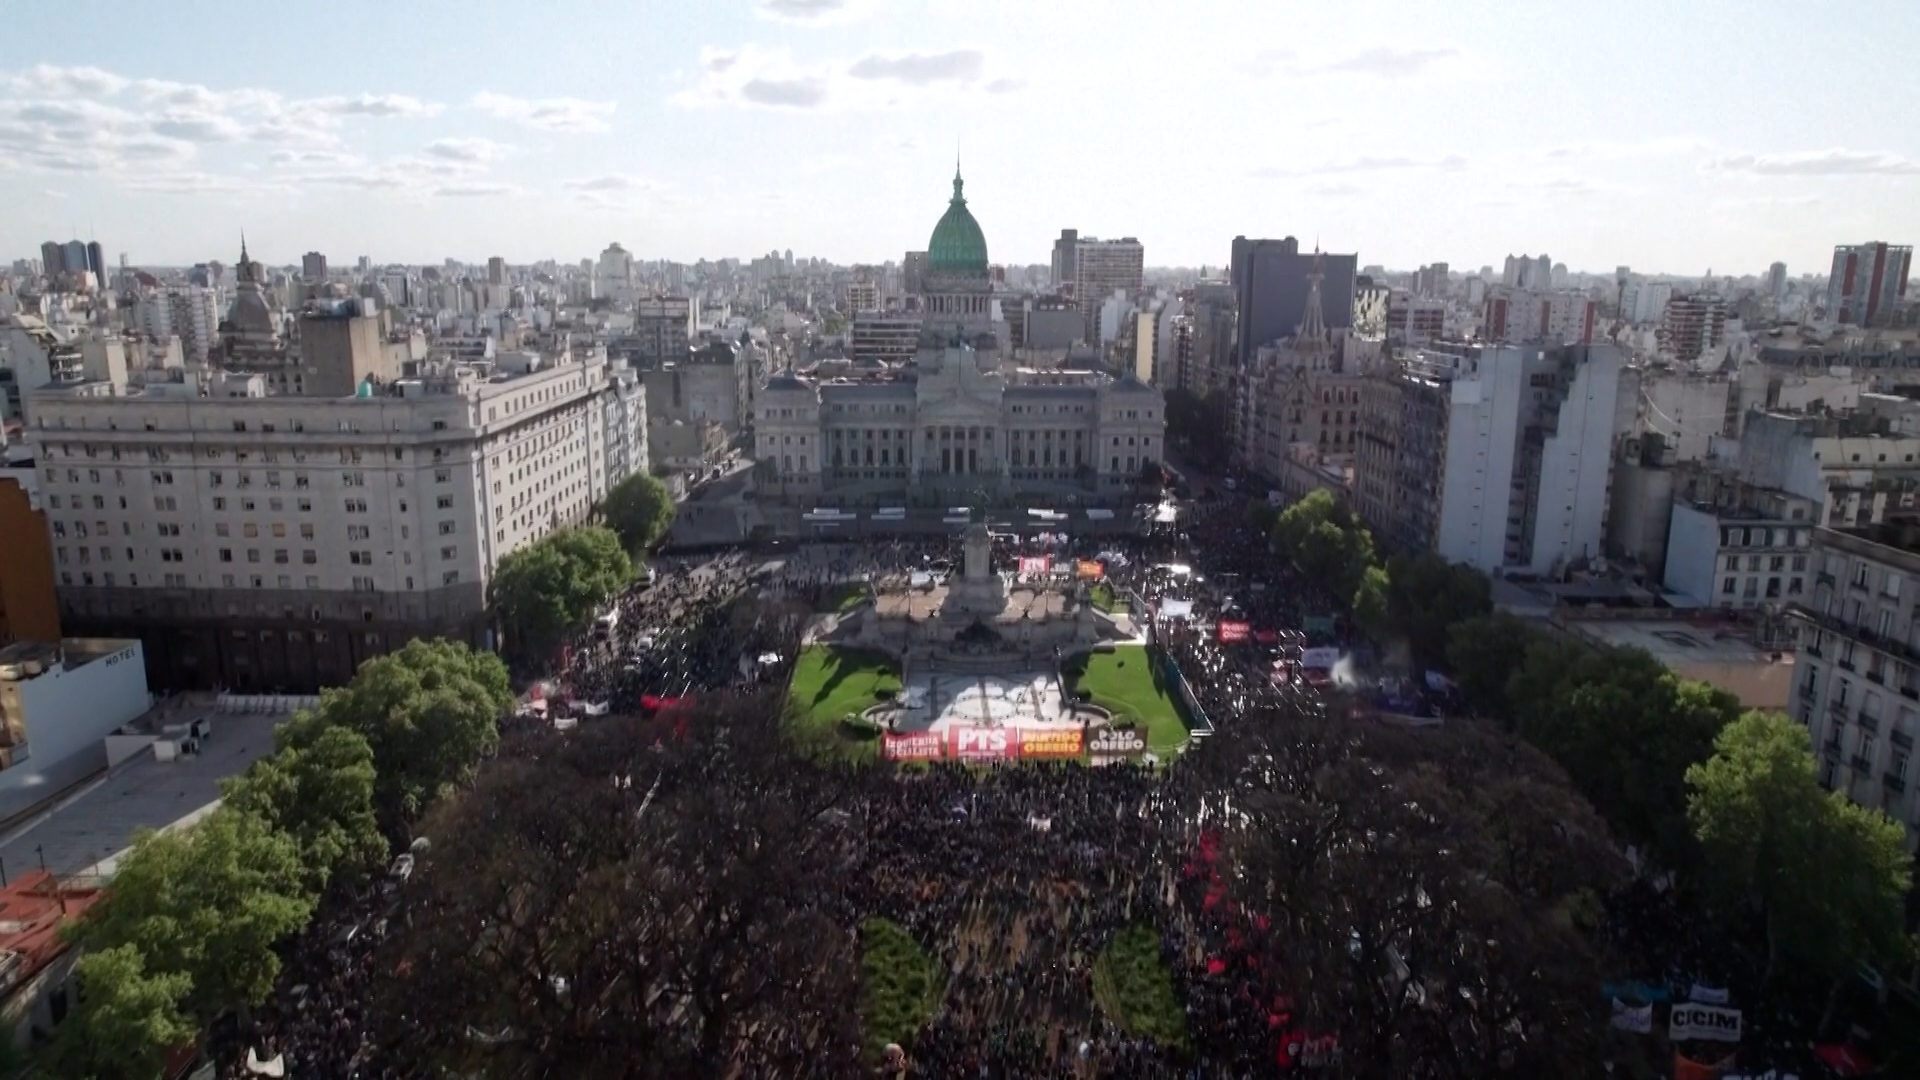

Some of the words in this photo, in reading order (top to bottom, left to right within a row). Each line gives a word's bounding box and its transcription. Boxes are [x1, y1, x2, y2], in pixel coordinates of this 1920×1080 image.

[105, 648, 136, 667] HOTEL
[957, 728, 1007, 750] PTS
[1672, 1010, 1738, 1029] CICIM
